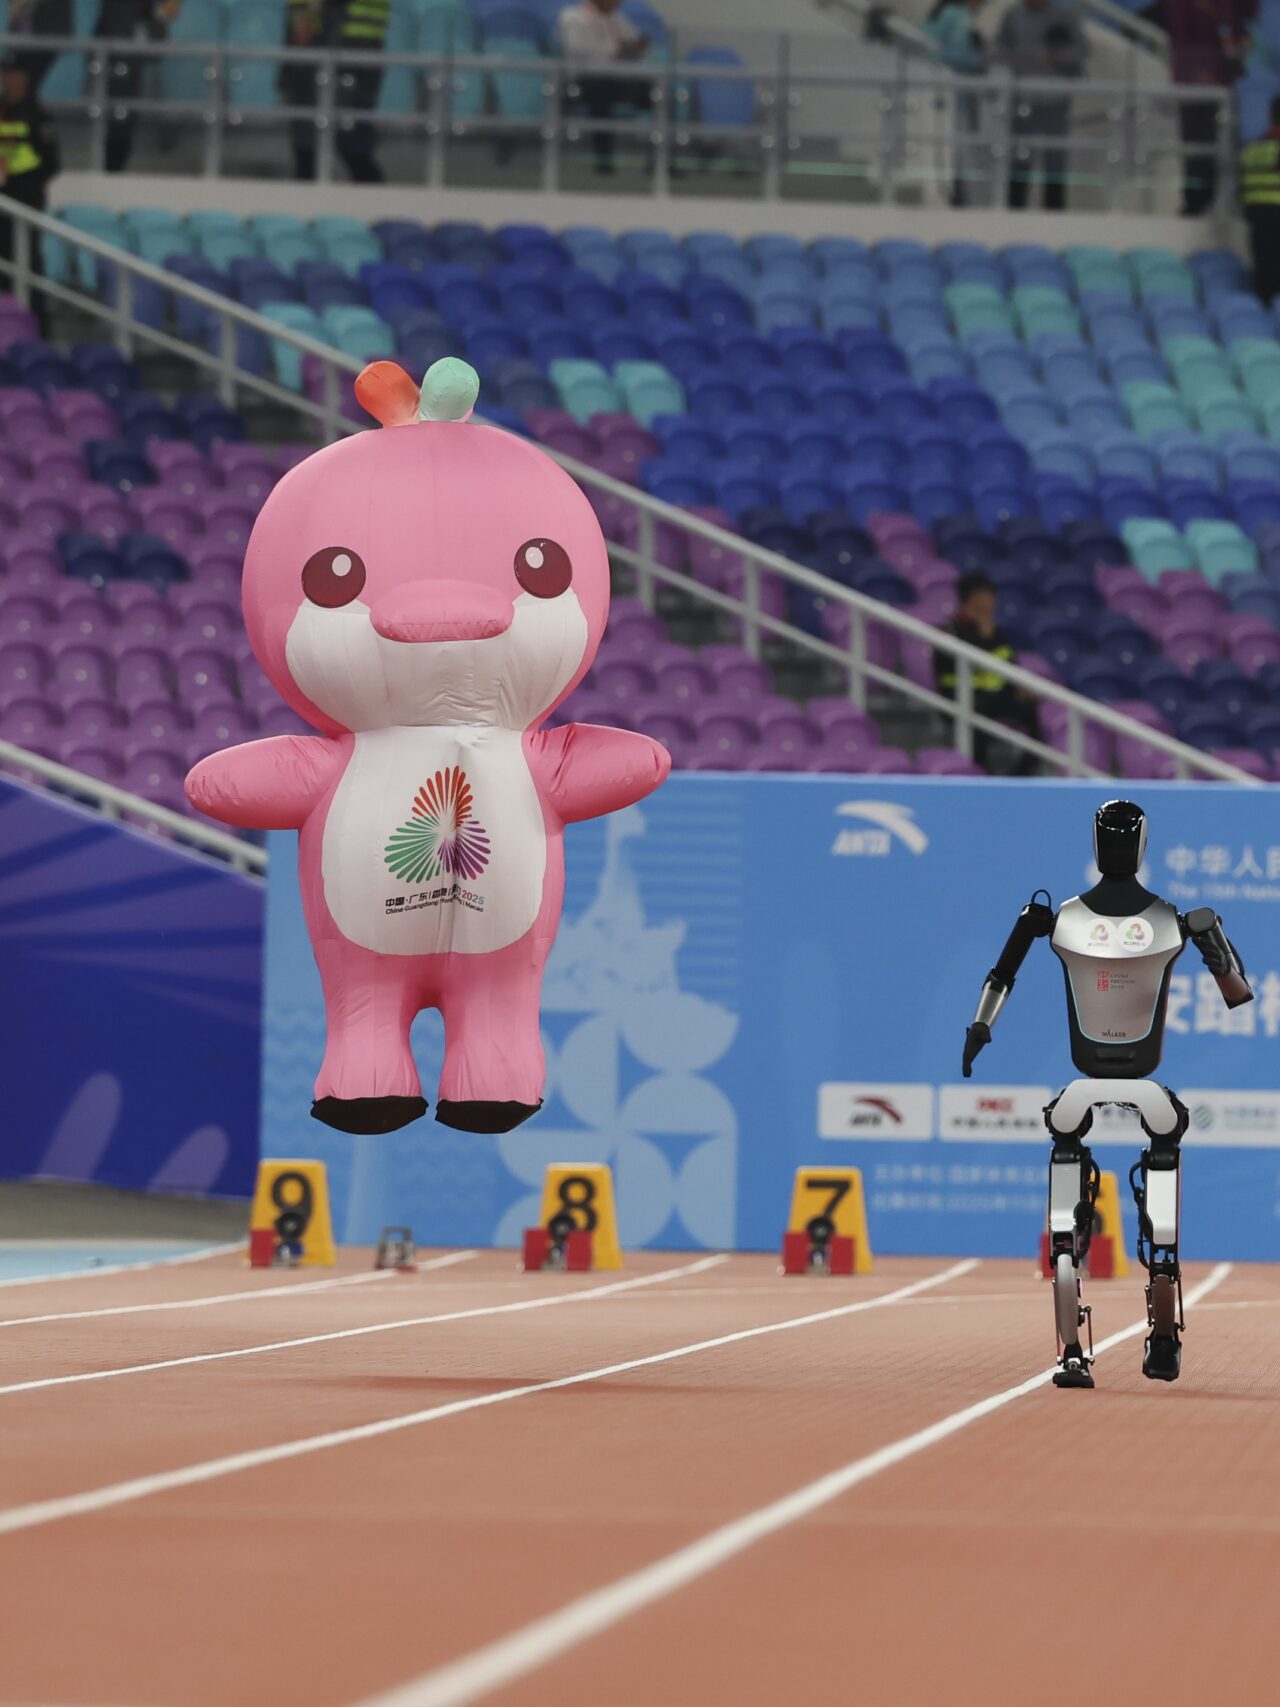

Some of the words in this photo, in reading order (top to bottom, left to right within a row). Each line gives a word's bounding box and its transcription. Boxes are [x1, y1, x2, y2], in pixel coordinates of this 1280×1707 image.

[462, 889, 485, 905] 2025
[272, 1171, 314, 1238] 9
[557, 1176, 598, 1235] 8
[805, 1179, 852, 1223] 7
